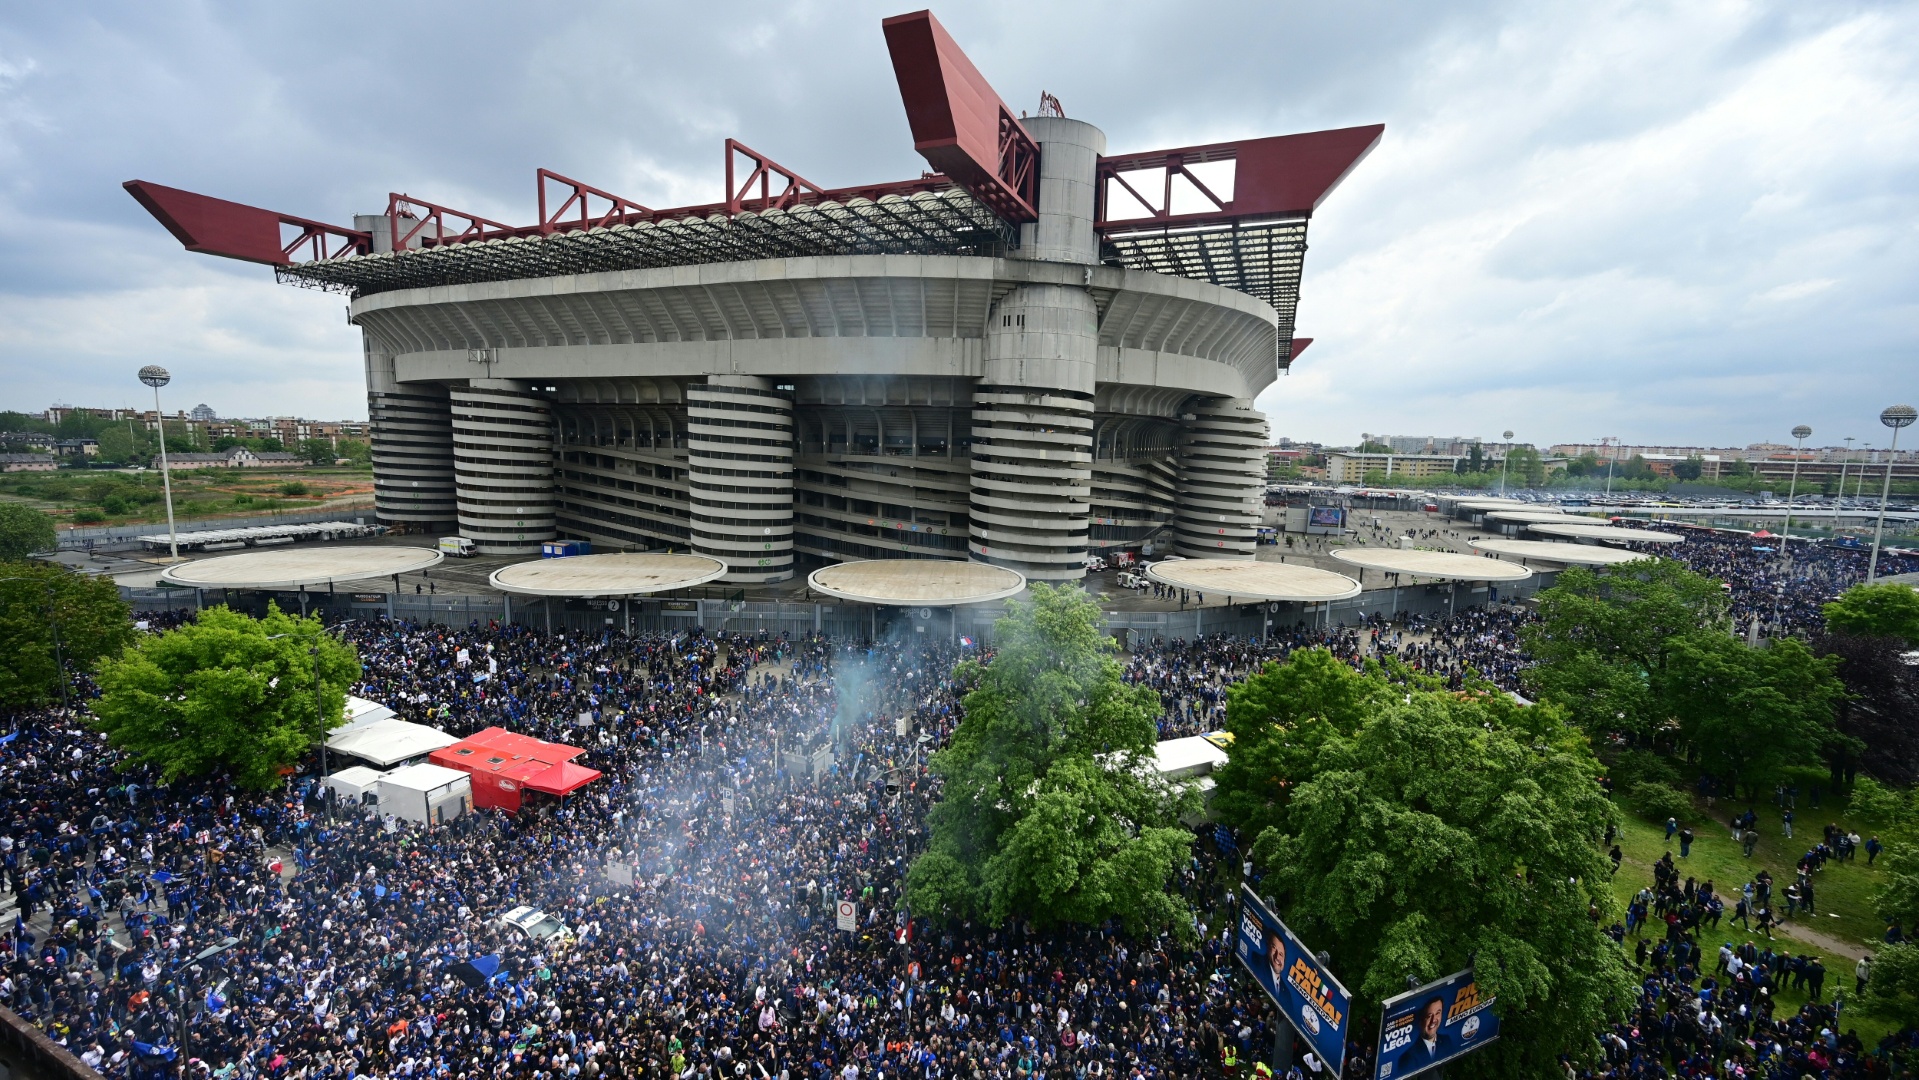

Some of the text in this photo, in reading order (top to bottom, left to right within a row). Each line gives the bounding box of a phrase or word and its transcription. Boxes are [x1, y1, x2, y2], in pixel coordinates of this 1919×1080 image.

[1241, 921, 1261, 950] LEGA
[1242, 913, 1263, 940] VOTO
[1295, 957, 1322, 988] PIÙ
[1289, 964, 1342, 1025] ITALIA!
[1291, 978, 1309, 999] MENO
[1308, 997, 1334, 1027] EUROPA
[1449, 1010, 1469, 1024] MENO
[1383, 1034, 1412, 1054] LEGA
[1385, 1024, 1413, 1042] VOTO
